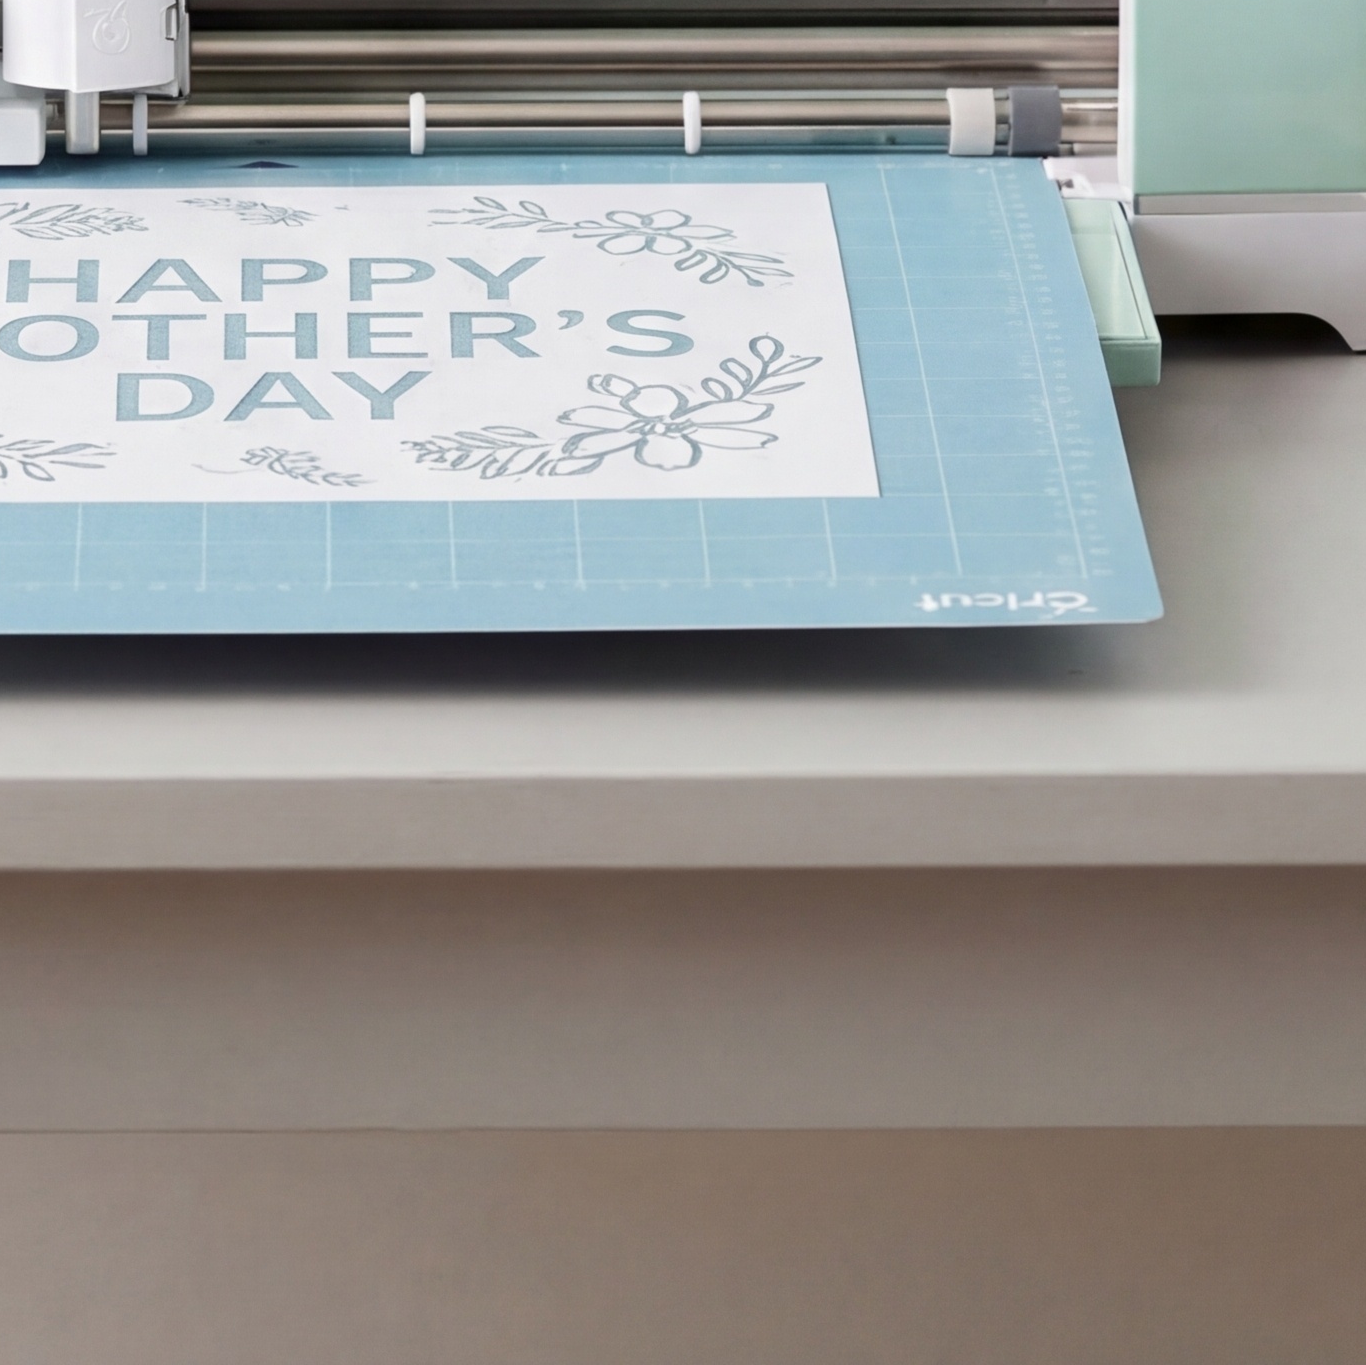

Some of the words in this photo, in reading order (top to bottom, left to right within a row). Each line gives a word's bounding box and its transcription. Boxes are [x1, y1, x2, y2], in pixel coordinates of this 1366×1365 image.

[6, 257, 546, 303] HAPPY
[116, 371, 432, 421] DAY
[915, 590, 1097, 617] Cricut
